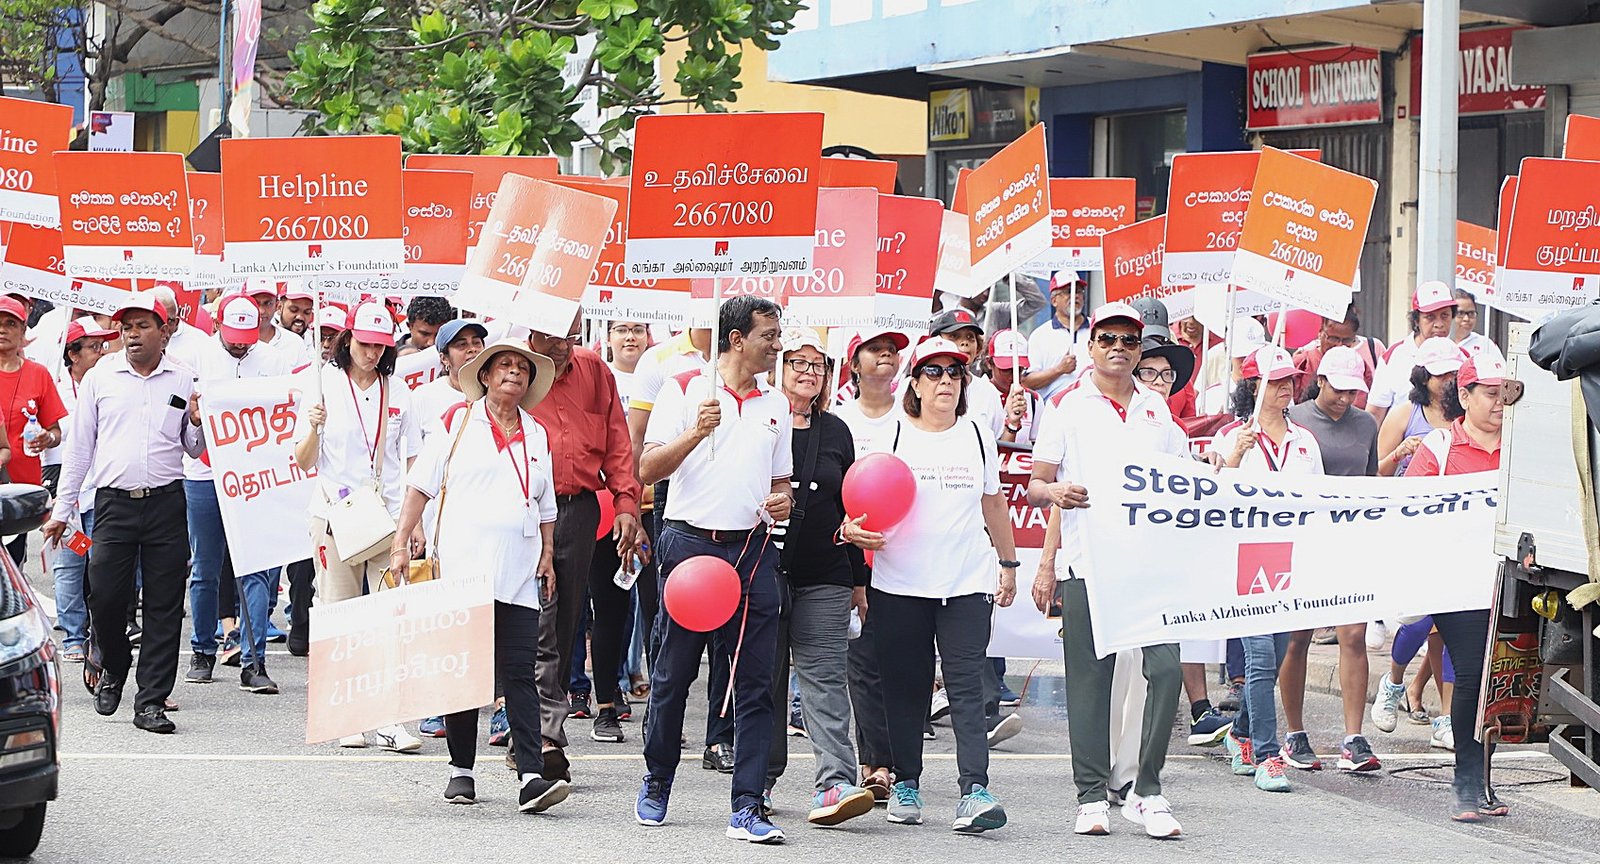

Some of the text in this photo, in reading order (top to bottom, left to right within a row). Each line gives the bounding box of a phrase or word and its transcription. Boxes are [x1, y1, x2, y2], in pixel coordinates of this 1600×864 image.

[1252, 59, 1379, 109] SCHOOL UNIFORMS
[932, 105, 966, 136] Nikon
[258, 173, 368, 204] Helpline
[259, 215, 369, 241] 2667080
[673, 201, 773, 227] 2667080
[232, 262, 266, 274] Lanka
[337, 259, 399, 272] Foundation
[1269, 239, 1323, 273] 2667080
[945, 482, 974, 490] together
[1121, 464, 1219, 501] Step
[1121, 502, 1316, 529] Together
[1161, 591, 1375, 627] Lanka Alzheimer's Foundation
